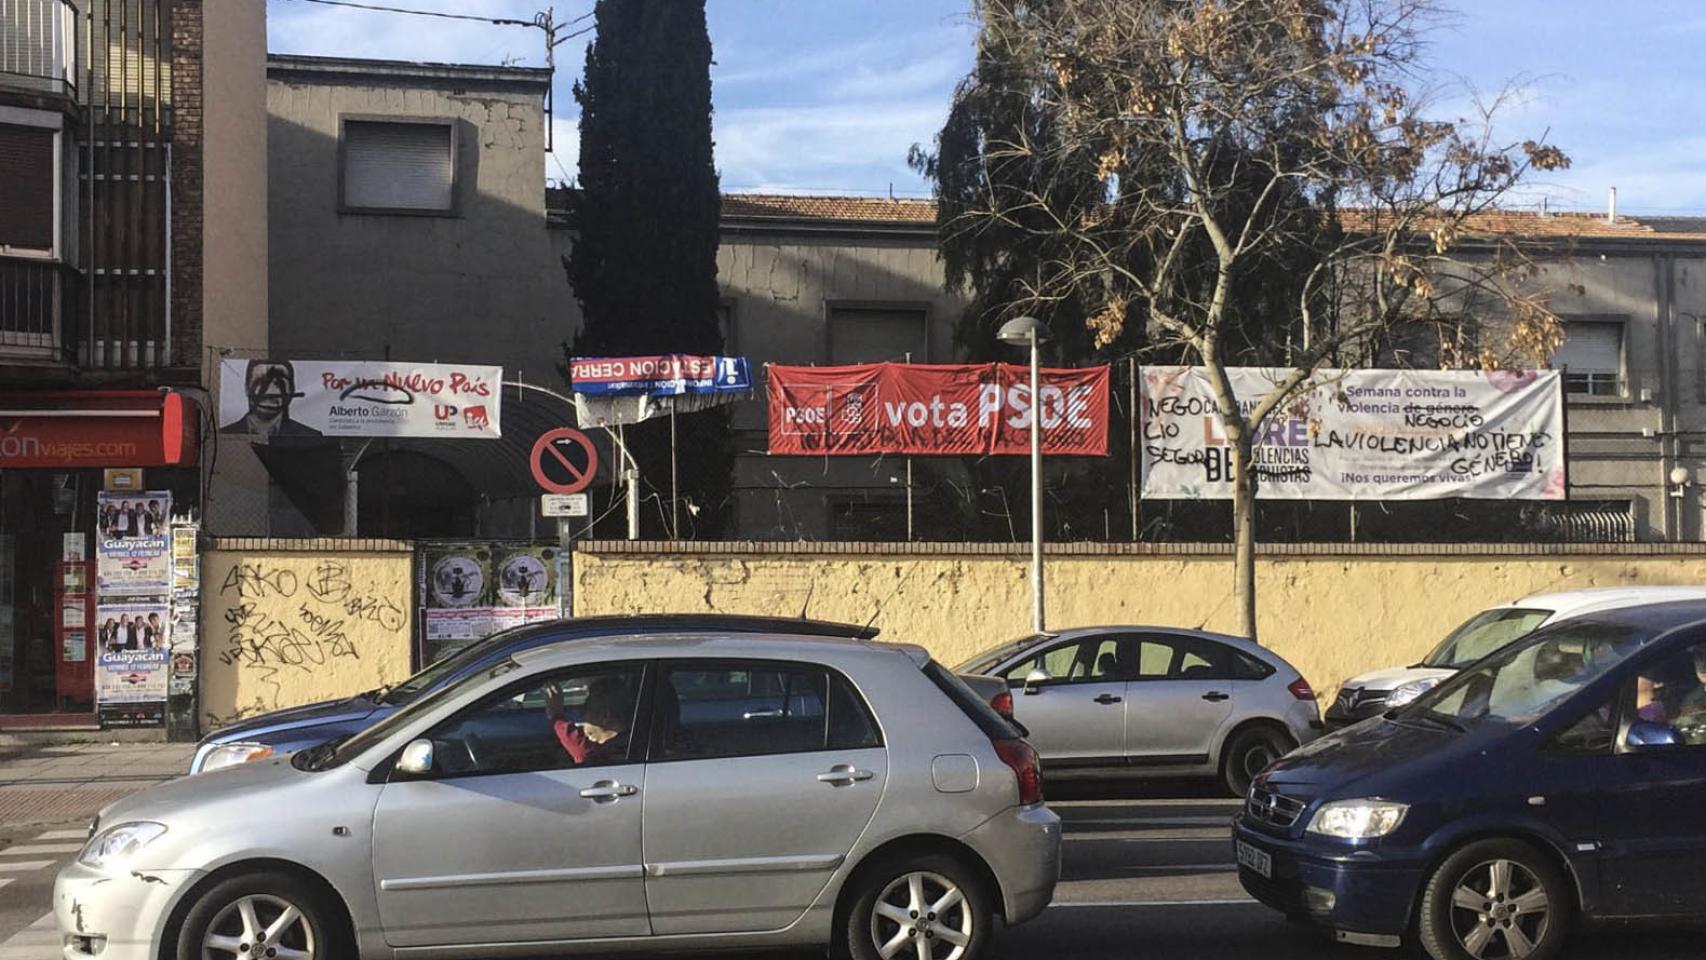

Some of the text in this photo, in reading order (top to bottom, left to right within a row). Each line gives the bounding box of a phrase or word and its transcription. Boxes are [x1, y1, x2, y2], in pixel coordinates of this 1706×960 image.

[322, 372, 350, 391] Por
[1346, 386, 1467, 398] Semana contra la
[329, 404, 409, 417] Alberto Garzón
[884, 382, 1093, 430] vota PSOE
[1338, 402, 1400, 414] violencia
[785, 406, 826, 424] PSOE
[1204, 416, 1309, 447] LBRE
[1373, 473, 1436, 484] queremos
